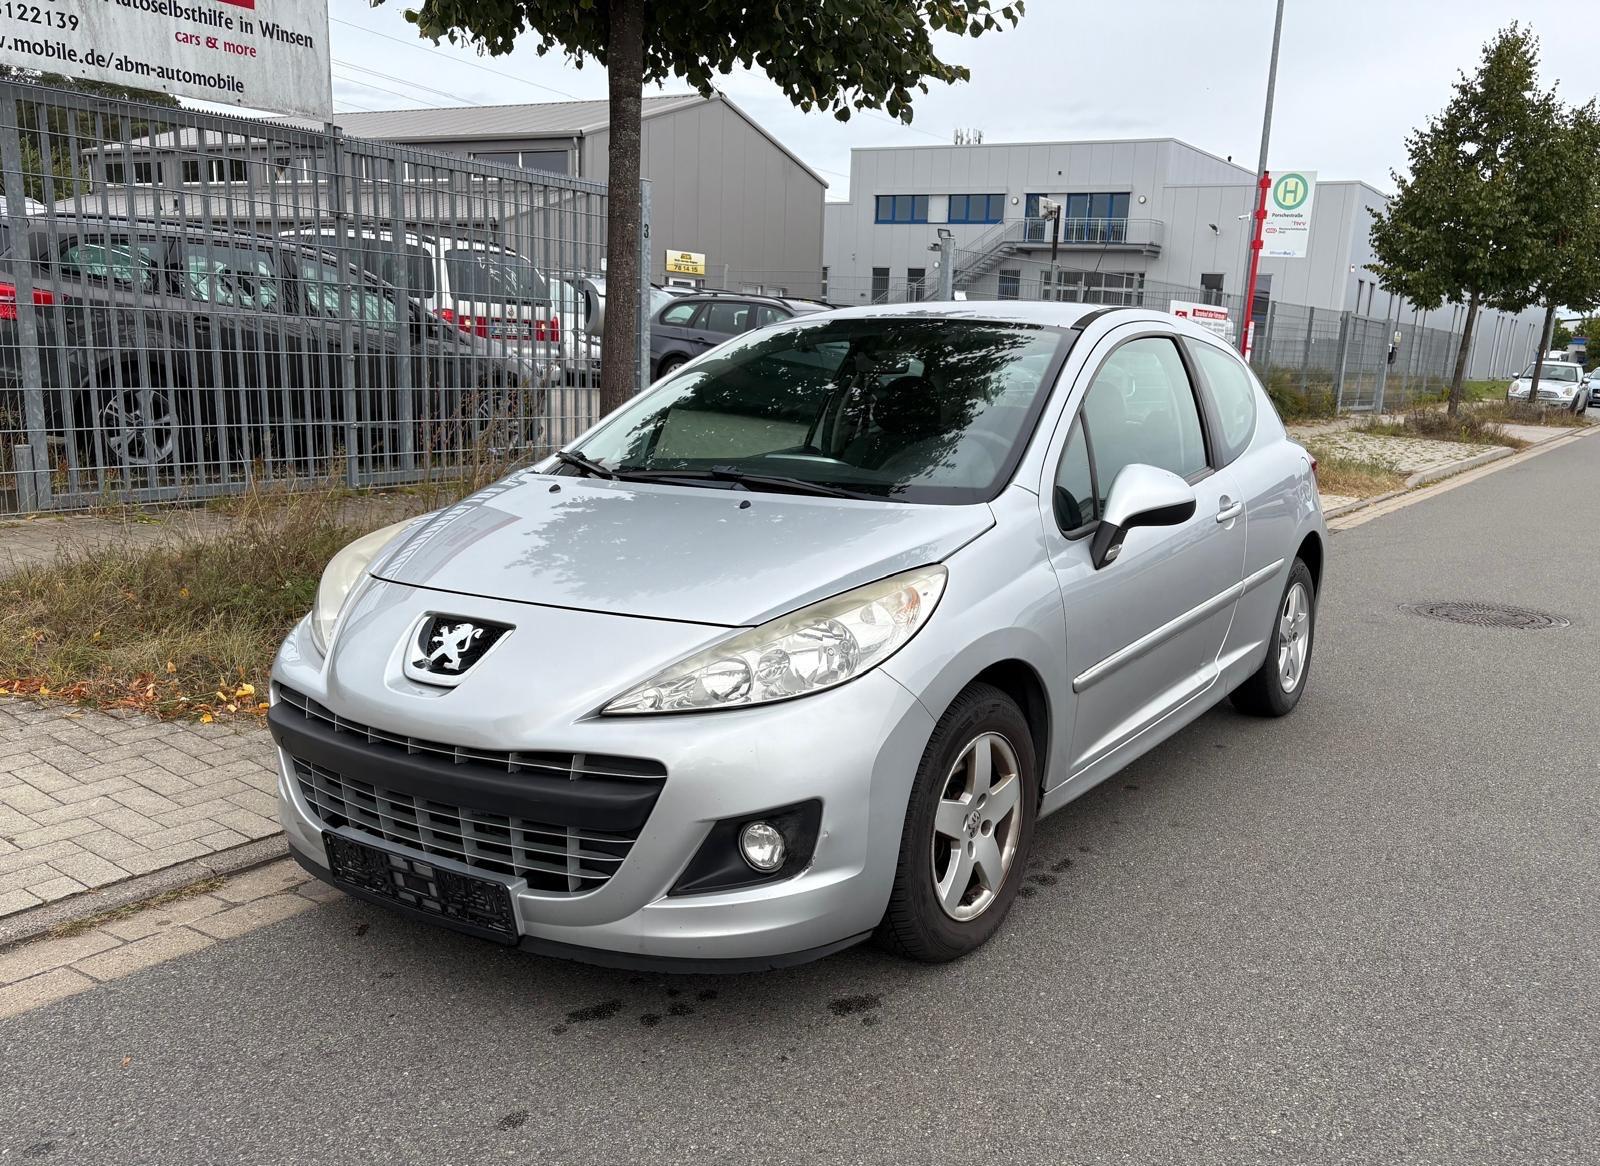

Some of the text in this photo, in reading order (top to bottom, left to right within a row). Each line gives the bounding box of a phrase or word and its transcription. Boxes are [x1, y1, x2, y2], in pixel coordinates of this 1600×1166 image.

[0, 1, 79, 31] 122139
[174, 31, 257, 58] cars & more
[239, 15, 254, 35] in
[258, 20, 313, 49] Winsen
[1282, 181, 1299, 202] H
[643, 223, 649, 239] 3
